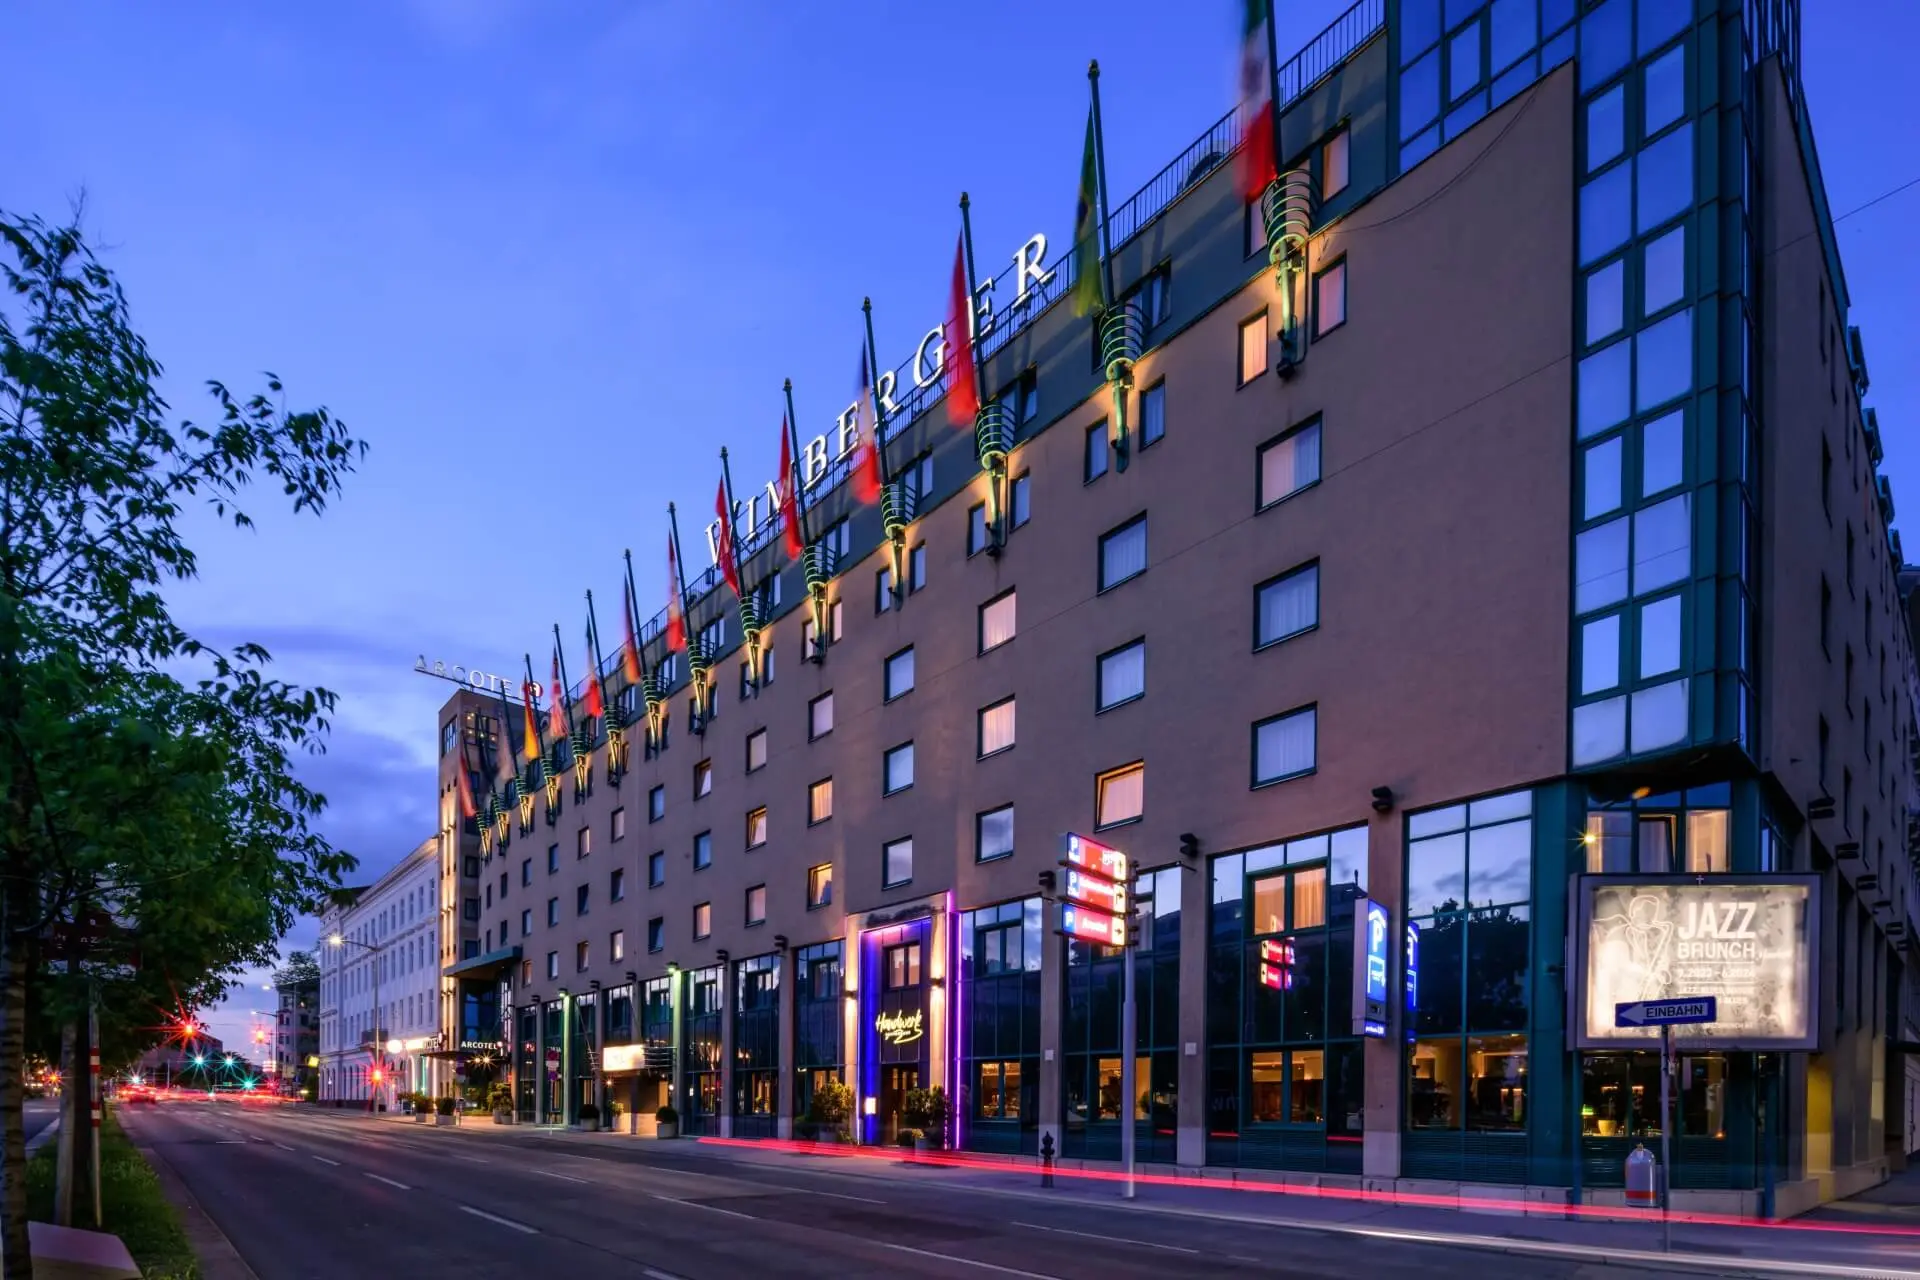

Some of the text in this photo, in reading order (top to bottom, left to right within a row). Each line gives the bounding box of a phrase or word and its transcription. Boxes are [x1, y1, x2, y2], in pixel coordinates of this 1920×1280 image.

[415, 653, 526, 699] ARCOTE
[1678, 902, 1757, 940] JAZZ
[1372, 918, 1384, 952] P
[1677, 941, 1756, 960] BRUNCH
[1646, 1005, 1704, 1018] EINBAHN
[460, 1040, 498, 1050] ARCOTEL
